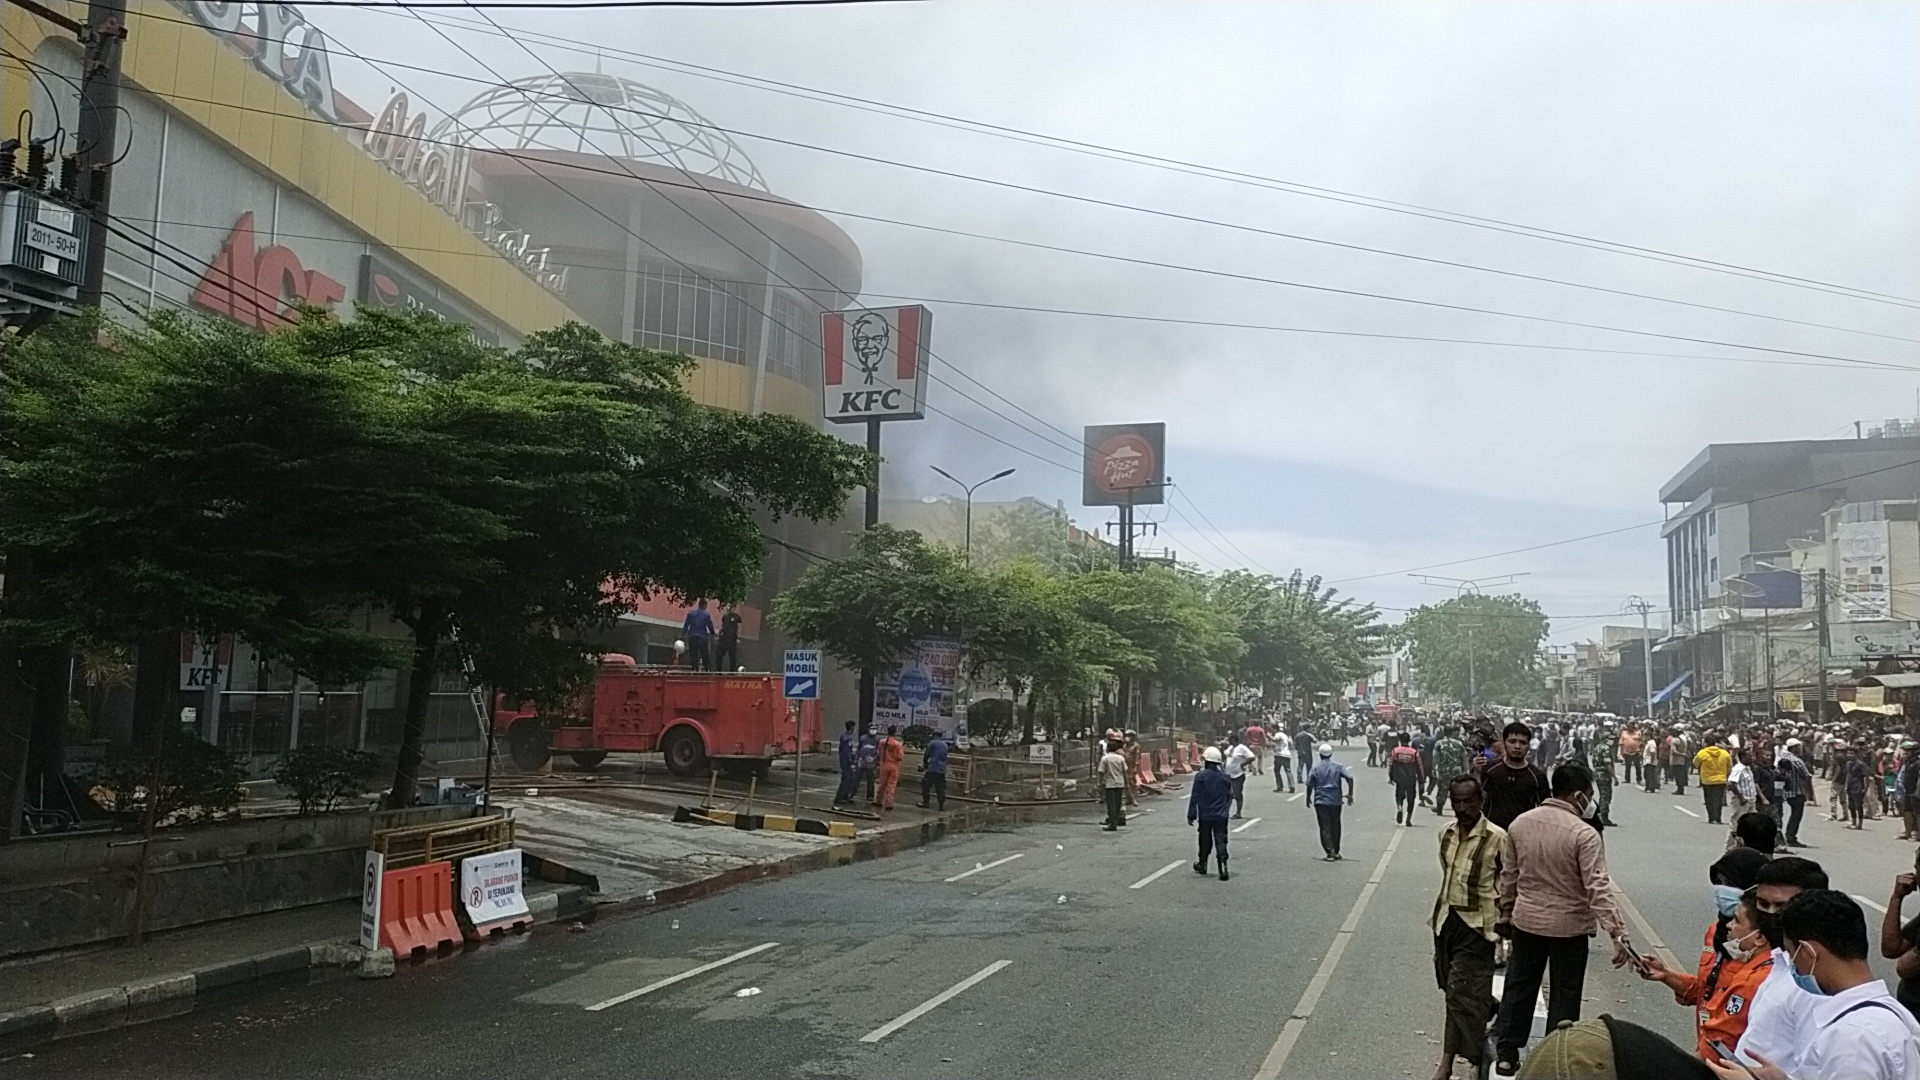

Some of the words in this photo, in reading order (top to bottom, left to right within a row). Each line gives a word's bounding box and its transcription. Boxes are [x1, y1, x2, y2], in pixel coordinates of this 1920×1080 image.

[365, 91, 473, 222] Mall
[56, 236, 77, 254] 50-H
[838, 388, 902, 414] KFC
[1104, 460, 1139, 476] Pizza
[1109, 468, 1138, 483] Hut
[786, 652, 818, 662] MASUK
[785, 663, 818, 674] MOBIL
[724, 680, 763, 690] MATRA
[902, 684, 928, 692] SMASH
[891, 711, 907, 720] MILK
